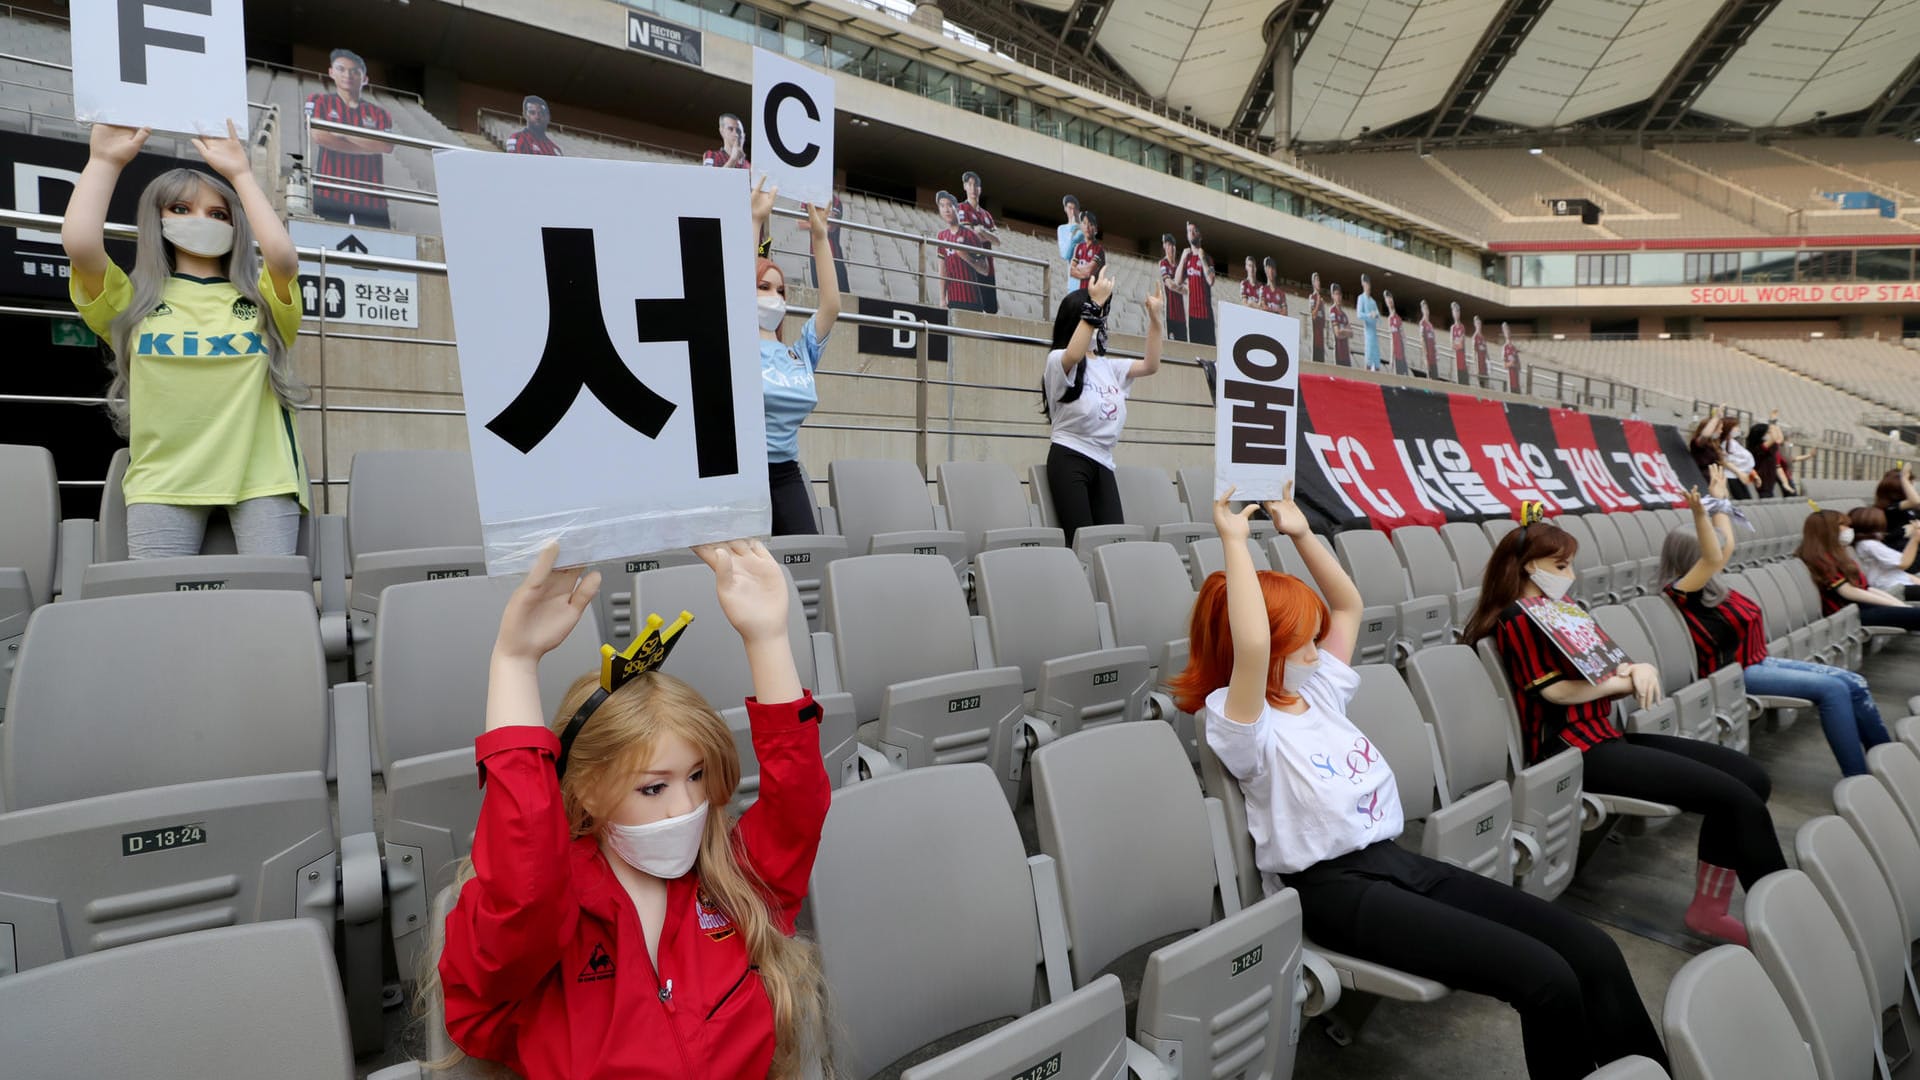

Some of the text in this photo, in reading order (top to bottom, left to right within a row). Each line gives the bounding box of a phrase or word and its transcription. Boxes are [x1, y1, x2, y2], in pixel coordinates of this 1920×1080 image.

[116, 0, 212, 85] F
[629, 17, 650, 46] N
[763, 81, 820, 167] C
[355, 284, 409, 304] 화장실
[356, 303, 409, 322] Toilet
[1690, 287, 1750, 304] SEOUL
[1756, 286, 1824, 303] WORLD
[1830, 286, 1870, 302] CUP
[484, 216, 739, 479] 서
[893, 309, 917, 349] D
[1224, 333, 1295, 465] 울
[1304, 431, 1687, 518] FC 서울 작은 거인 고요한
